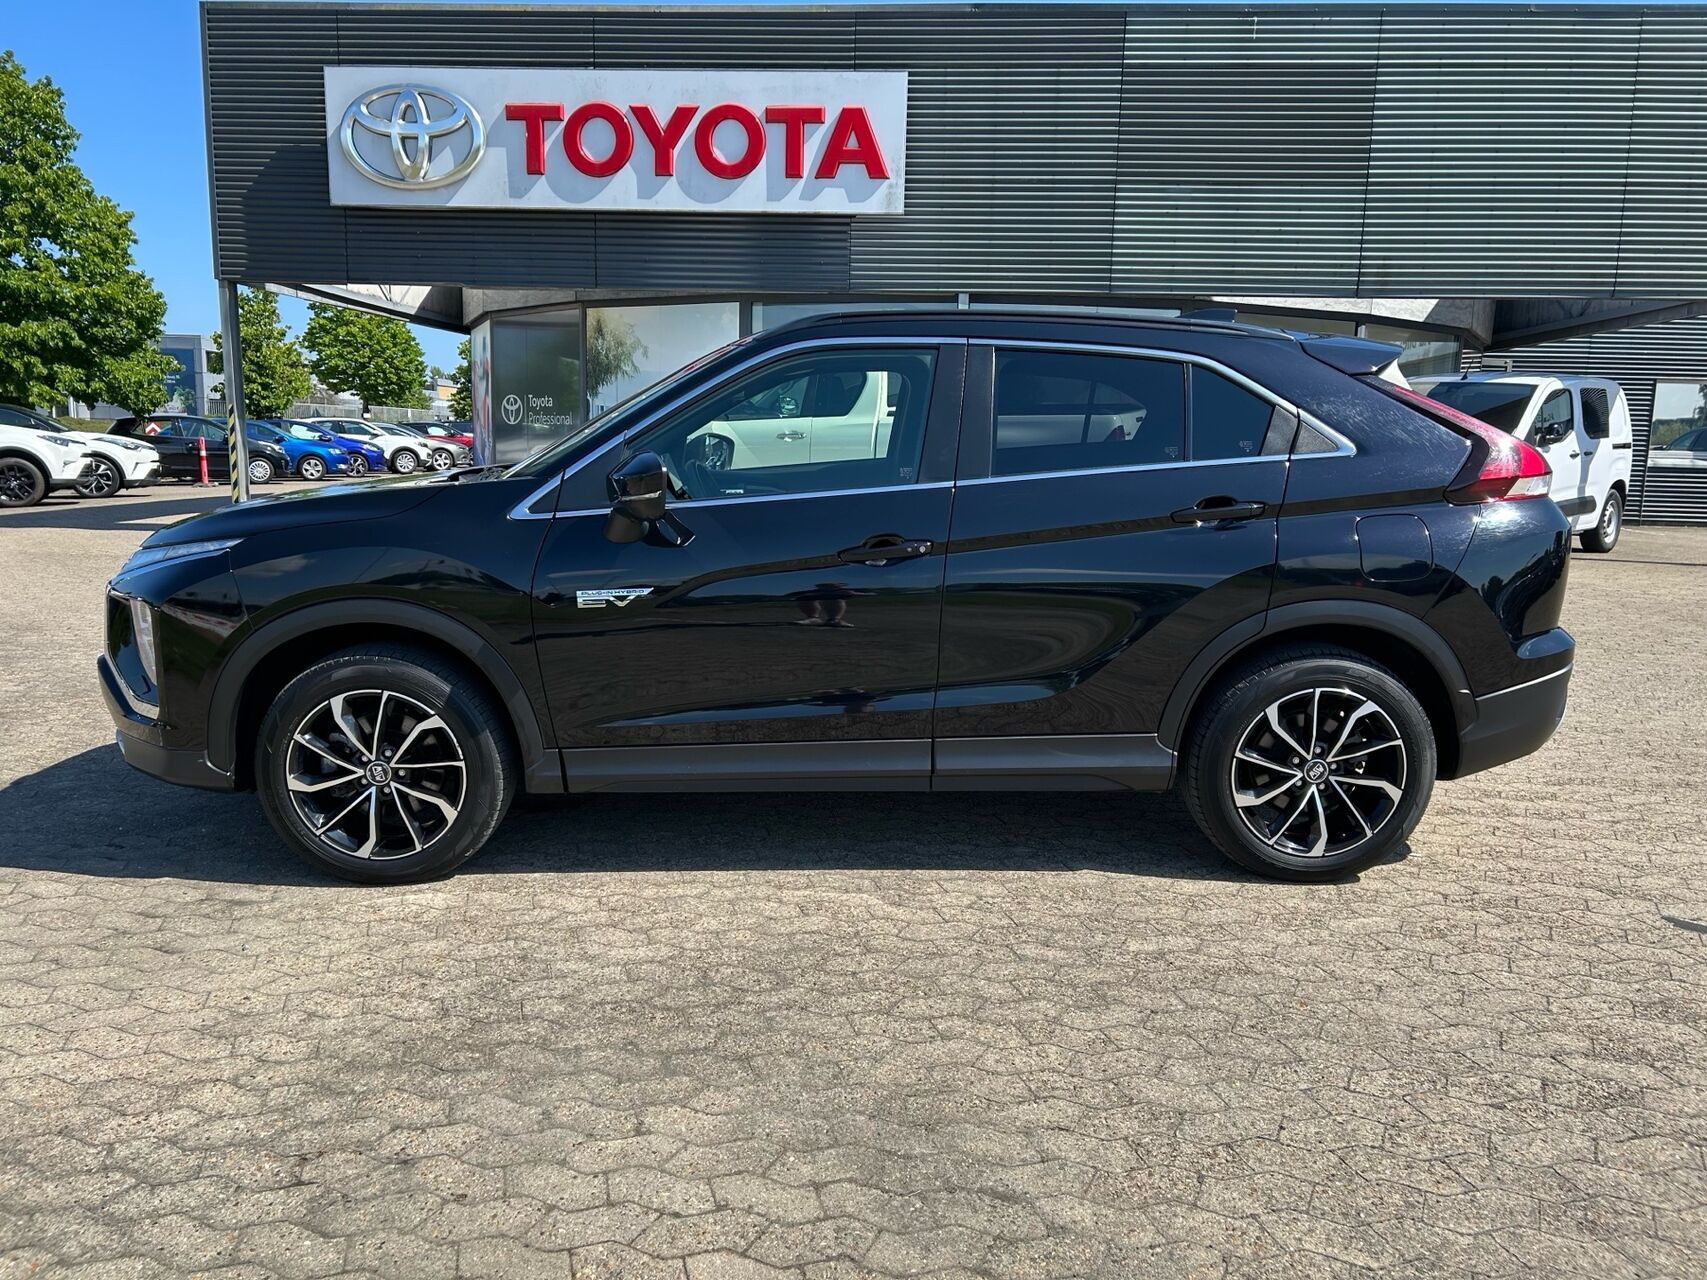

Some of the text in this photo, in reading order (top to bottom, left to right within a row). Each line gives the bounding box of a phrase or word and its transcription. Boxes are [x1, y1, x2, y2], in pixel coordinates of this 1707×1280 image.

[505, 101, 890, 179] TOYOTA
[528, 394, 553, 410] Toyota
[528, 411, 573, 425] Professional
[577, 595, 638, 608] EV
